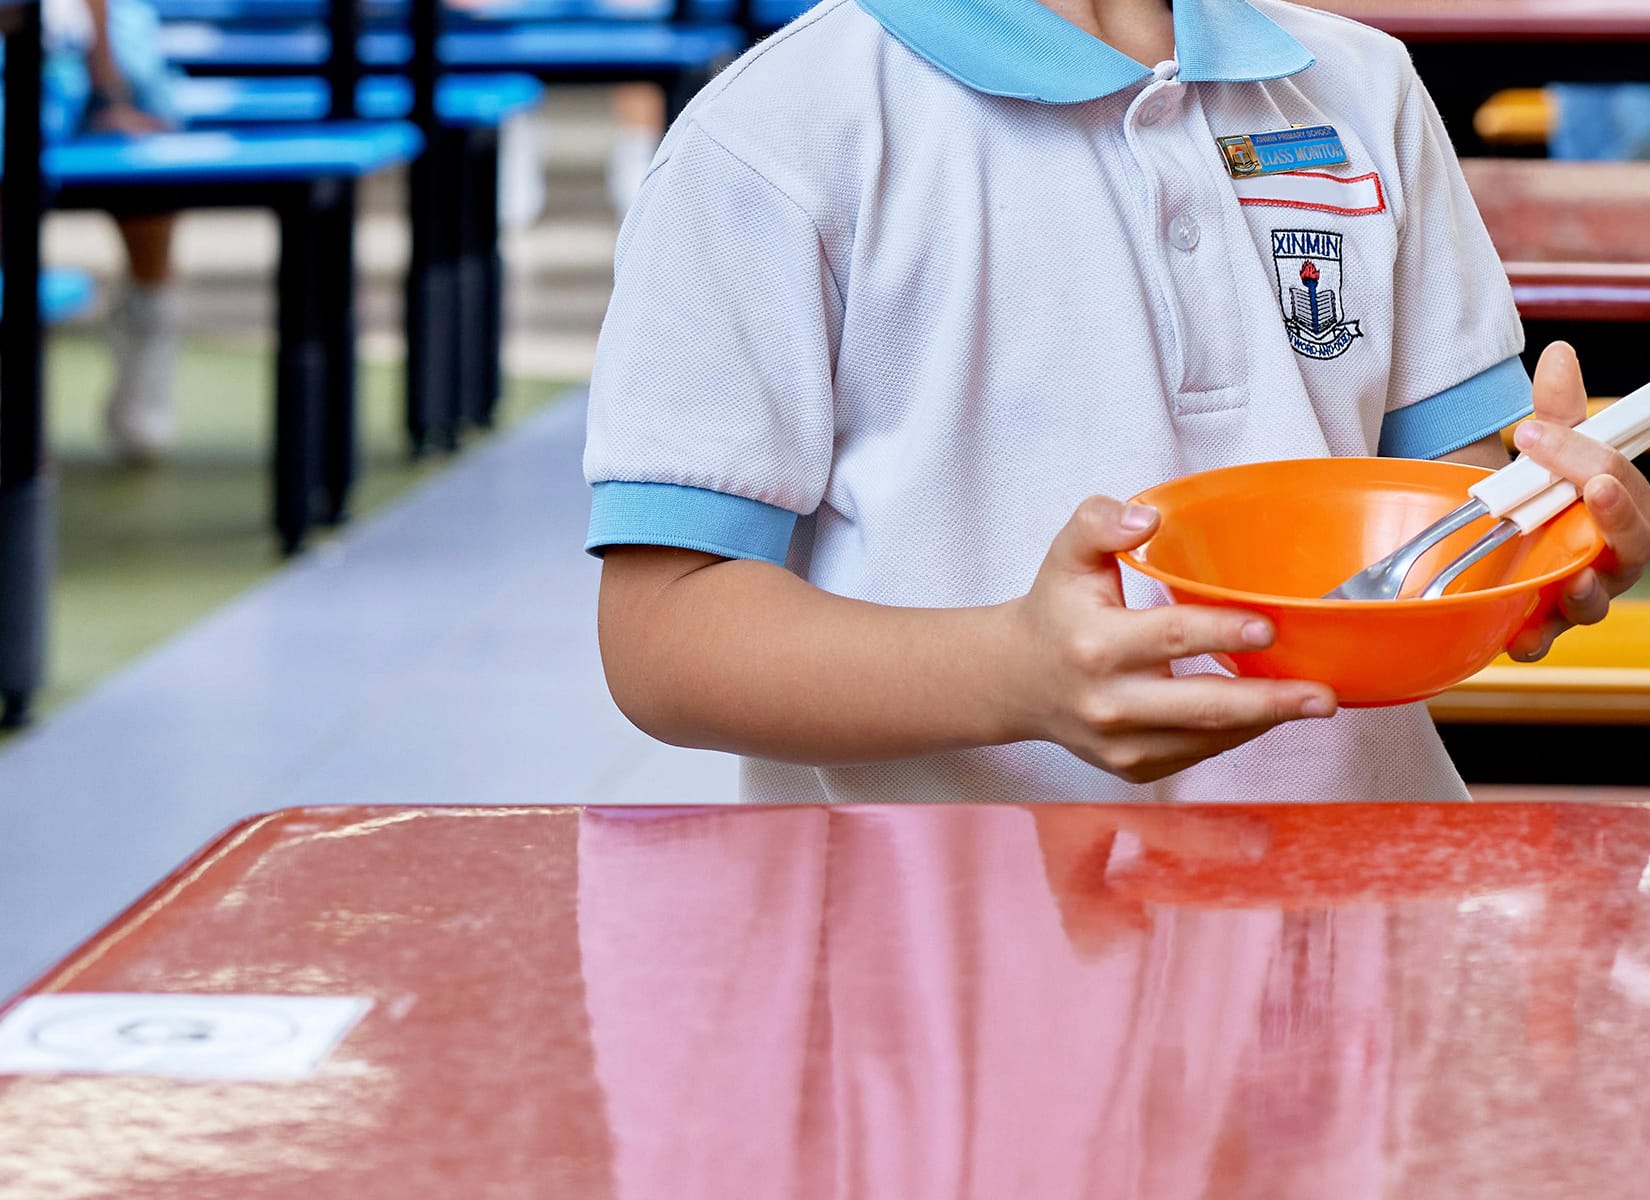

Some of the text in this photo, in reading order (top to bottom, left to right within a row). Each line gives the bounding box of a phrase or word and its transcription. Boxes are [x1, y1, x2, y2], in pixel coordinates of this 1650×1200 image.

[1260, 142, 1344, 166] CLASS MONITOR
[1274, 233, 1339, 257] XINMIN
